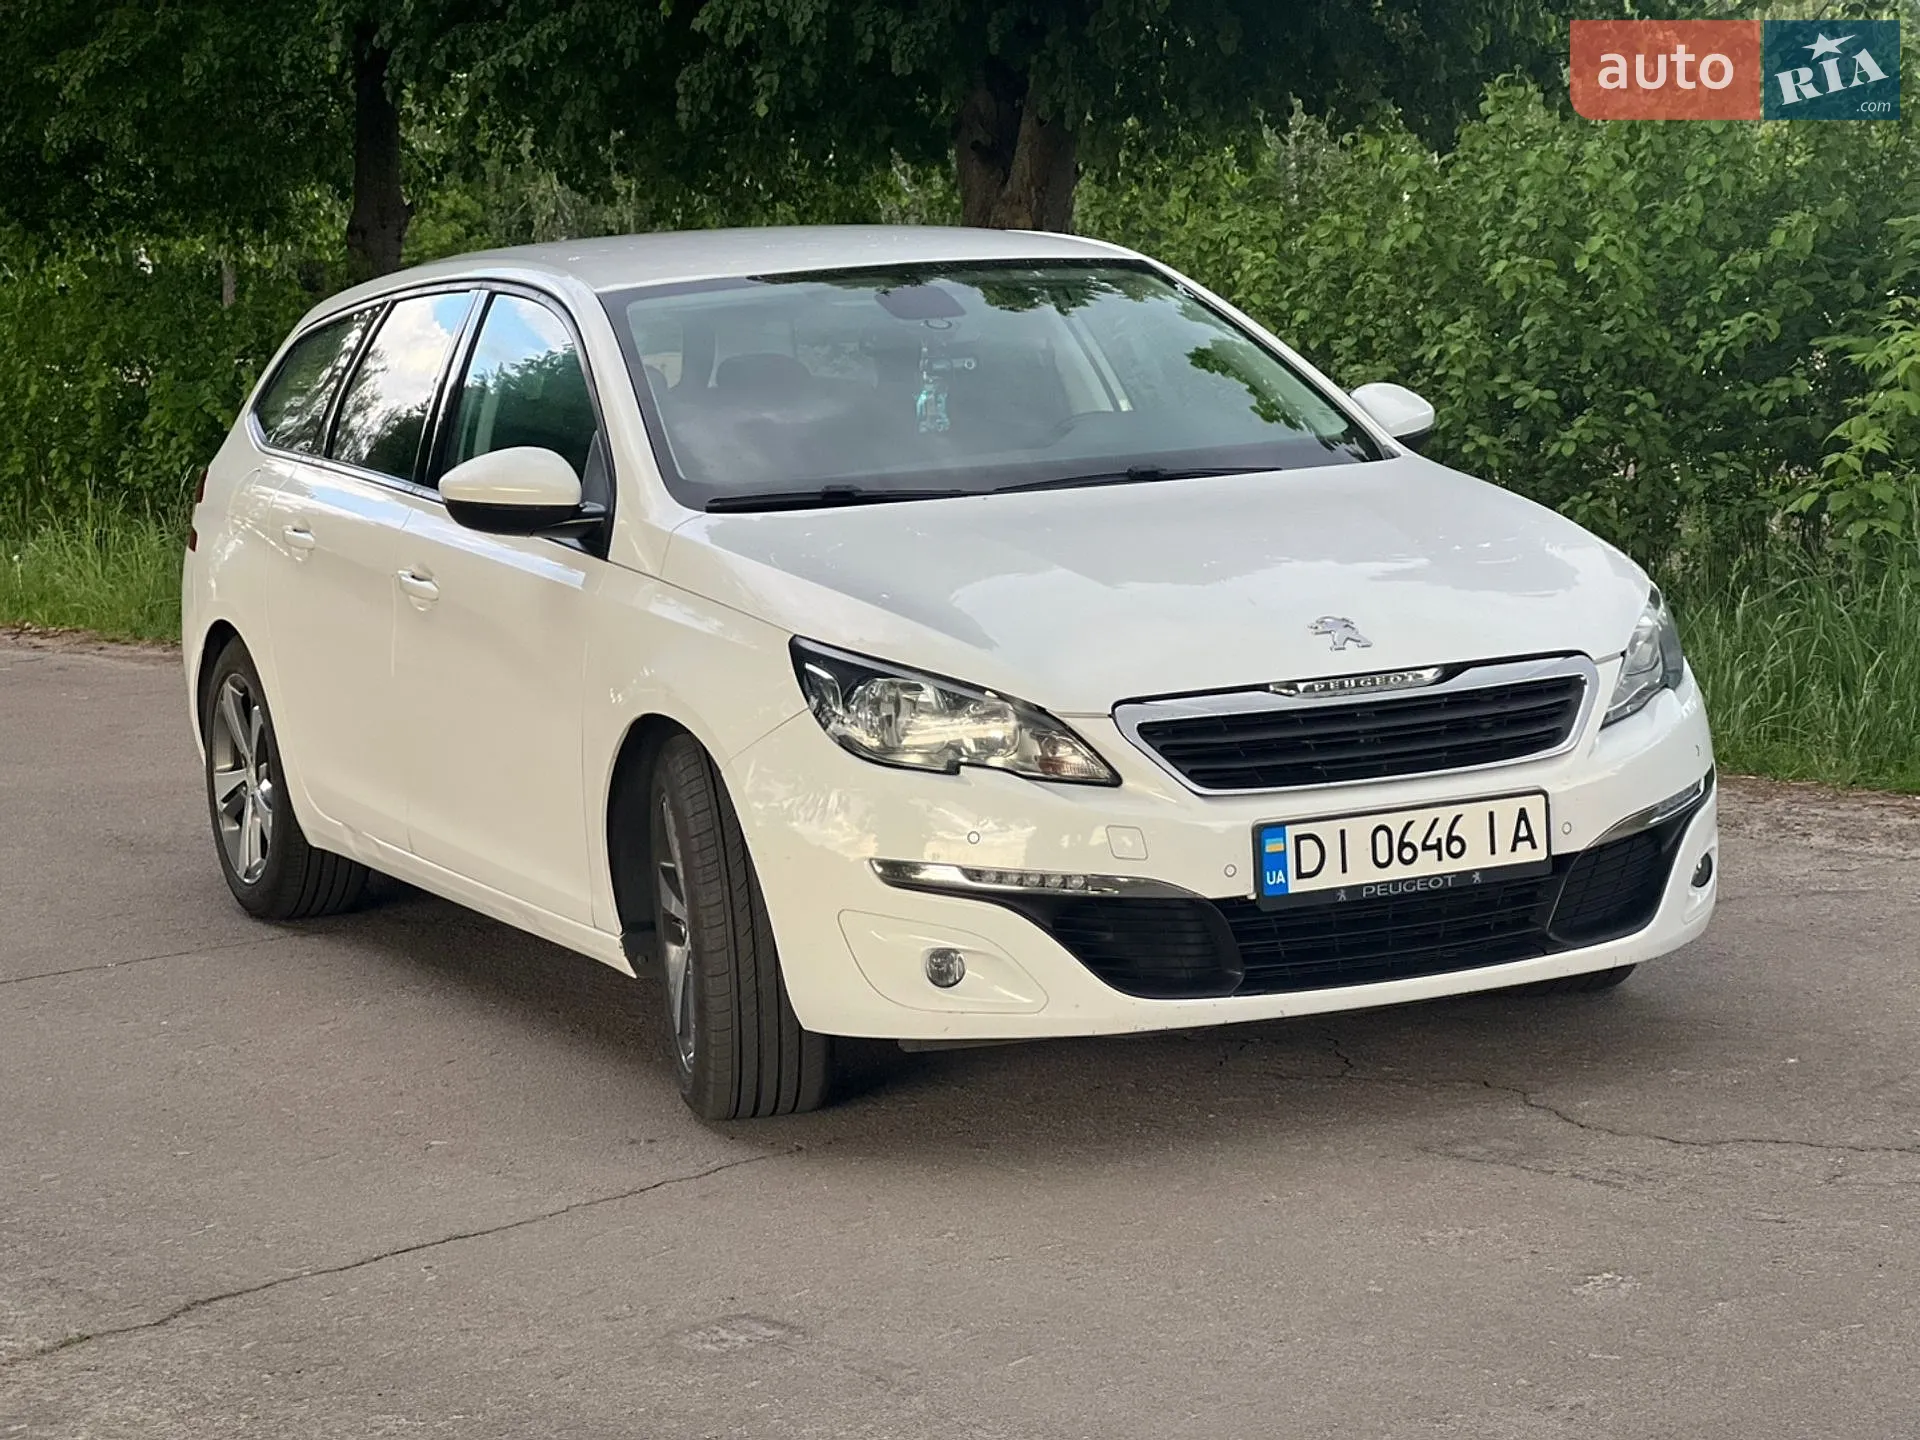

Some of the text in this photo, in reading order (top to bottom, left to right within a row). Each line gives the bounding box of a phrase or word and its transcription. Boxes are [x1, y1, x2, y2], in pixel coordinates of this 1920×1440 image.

[1313, 672, 1418, 692] PEUGEOT
[1294, 807, 1537, 880] DI 0646 IA
[1266, 871, 1286, 885] UA
[1362, 875, 1457, 898] PEUGEOT
